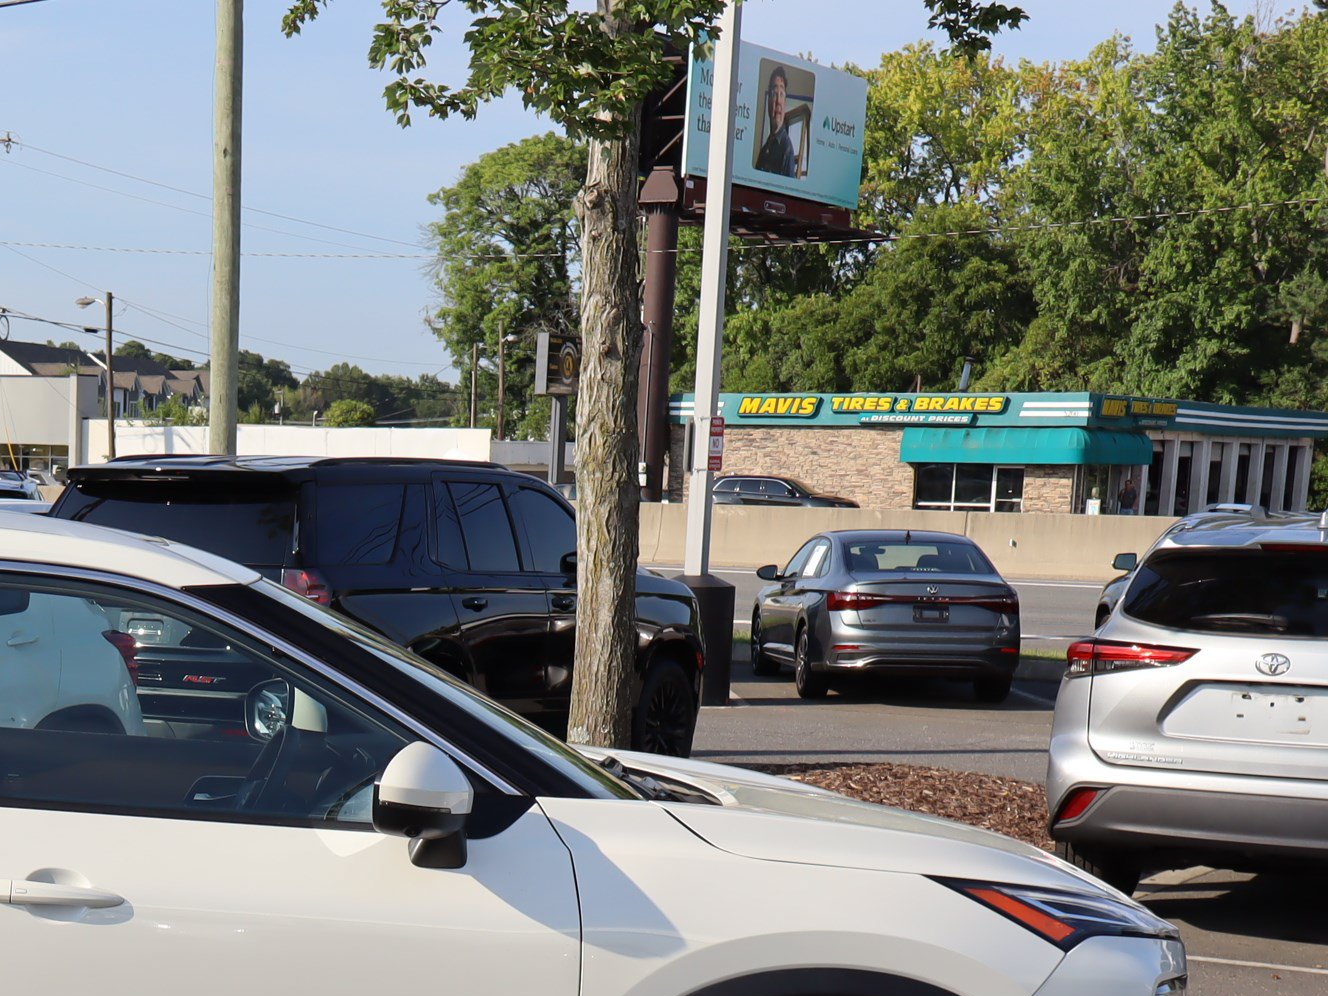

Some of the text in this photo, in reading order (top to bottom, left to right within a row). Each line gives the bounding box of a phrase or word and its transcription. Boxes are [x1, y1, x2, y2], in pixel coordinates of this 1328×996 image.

[831, 117, 855, 138] Upstart
[738, 397, 1006, 414] MAVIS TIRES & BRAKES
[928, 415, 969, 423] PRICES
